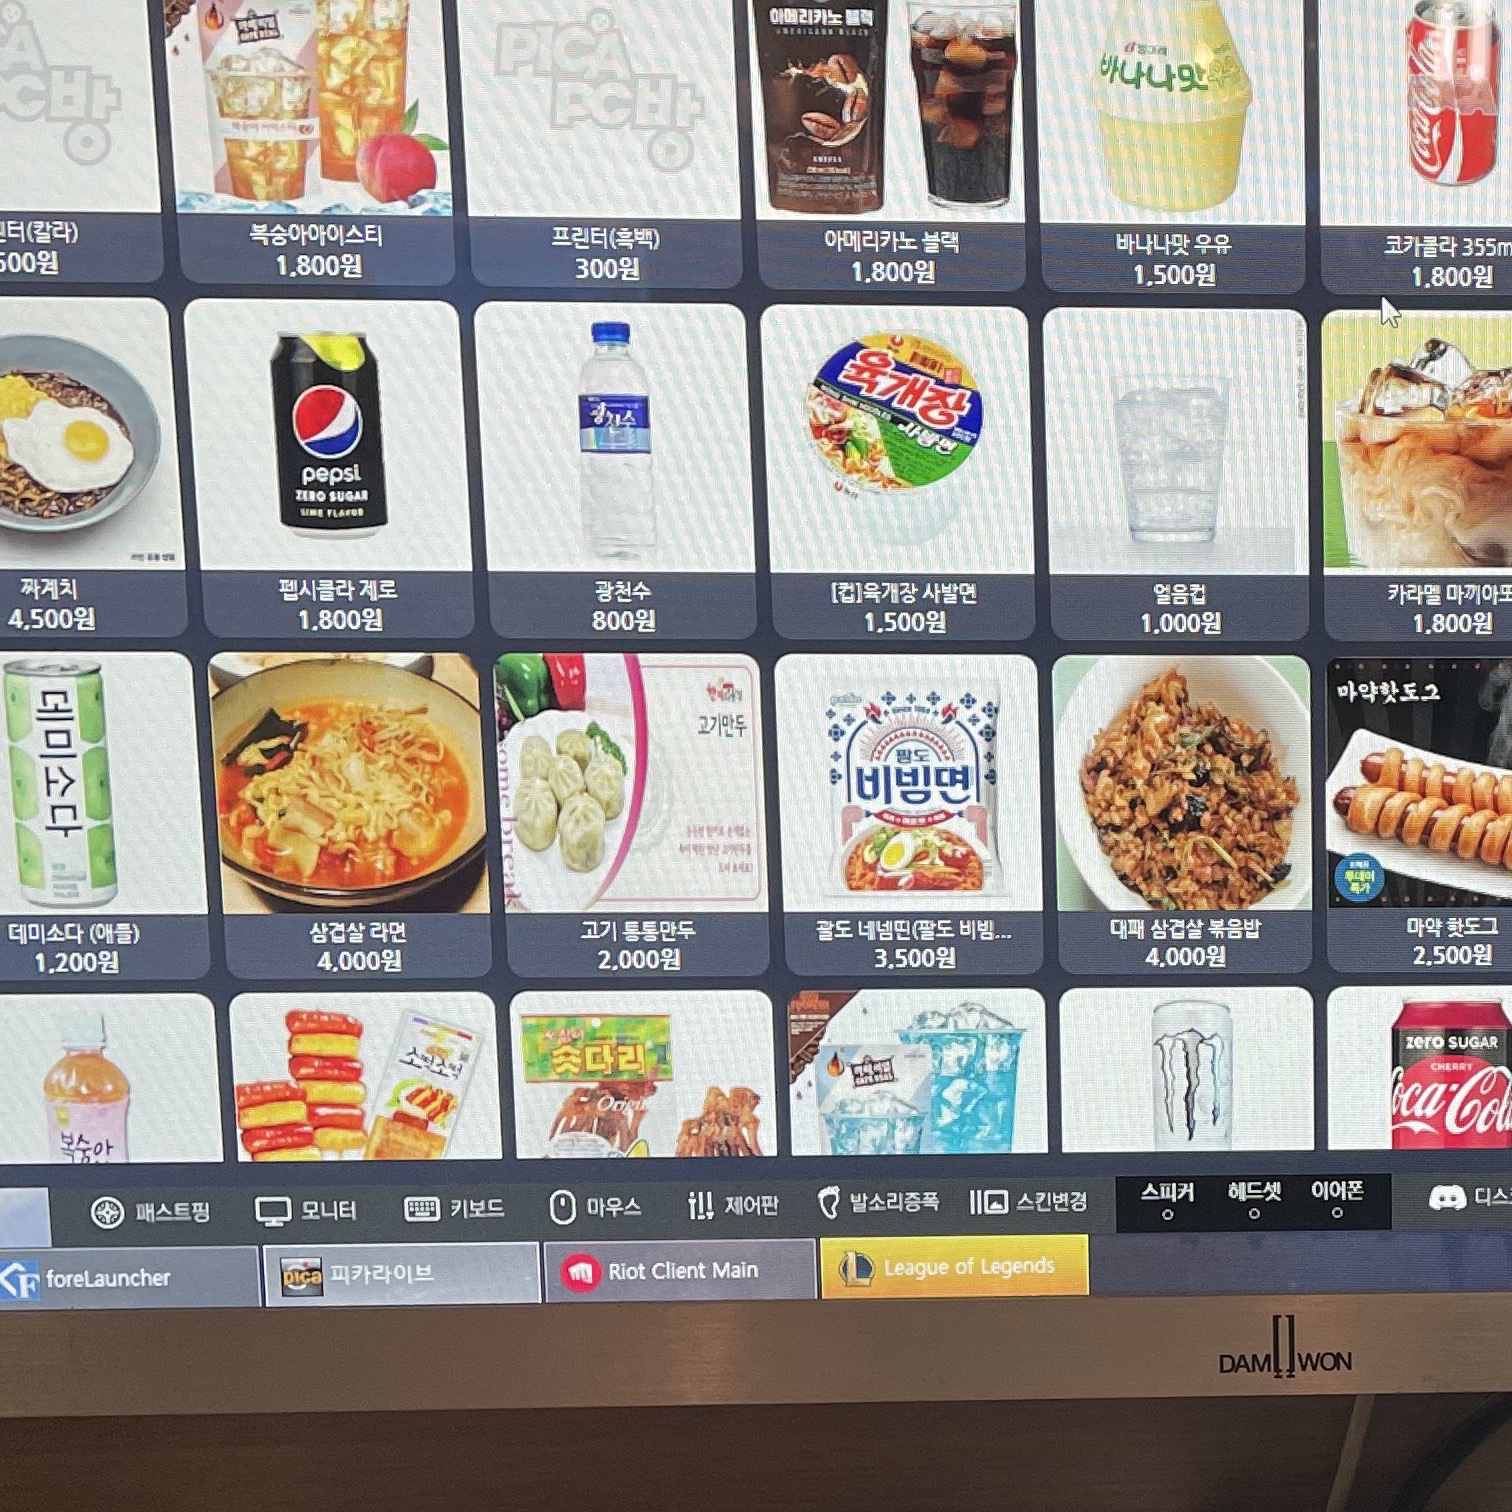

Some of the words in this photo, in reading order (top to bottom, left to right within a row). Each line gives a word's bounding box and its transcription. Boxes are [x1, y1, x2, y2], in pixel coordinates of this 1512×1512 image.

[1101, 53, 1208, 92] 바나나맛
[249, 223, 384, 247] 복숭아아이스티
[551, 227, 661, 251] 프린터(흑백)
[825, 230, 918, 254] 아메리카노
[922, 231, 960, 254] 블랙
[1116, 233, 1190, 256] 바나나맛
[1194, 233, 1233, 255] 우유
[1384, 235, 1458, 258] 코카콜라
[275, 254, 364, 279] 1,800원
[575, 257, 640, 281] 300원
[851, 260, 936, 286] 1,800원
[1133, 263, 1217, 288] 1,500원
[1411, 265, 1494, 290] 1,800원
[838, 347, 972, 429] 육개장
[302, 463, 361, 487] pepsi
[295, 489, 326, 501] ZERO
[329, 490, 368, 502] SUGAR
[20, 577, 78, 601] 짜계치
[279, 578, 355, 602] 펩시콜라
[359, 578, 398, 601] 제로
[595, 580, 653, 604] 광천수
[830, 582, 916, 605] [컵]육개장
[922, 582, 978, 605] 사발면
[1153, 583, 1207, 606] 얼음컵
[1386, 584, 1442, 606] 카라멜
[8, 607, 96, 632] 4,500원
[298, 607, 384, 632] 1,800원
[591, 609, 657, 634] 800원
[864, 611, 948, 635] 1,500원
[1140, 612, 1222, 636] 1,000원
[1413, 612, 1493, 636] 1,800원
[1337, 680, 1441, 704] 마약핫도그
[698, 713, 748, 738] 고기만두
[36, 690, 84, 838] 데미소다
[856, 764, 971, 804] 비빔면
[8, 923, 84, 945] 데미소다
[89, 923, 141, 945] (애플)
[310, 922, 365, 945] 삼겹살
[369, 922, 407, 944] 라면
[581, 920, 617, 943] 고기
[622, 920, 697, 944] 통통만두
[815, 919, 854, 942] 괄도
[858, 919, 954, 943] 네넴띤(팔도
[1110, 918, 1146, 940] 대패
[1151, 918, 1204, 940] 삼겹살
[1208, 917, 1262, 940] 볶음밥
[1406, 917, 1442, 938] 마약
[1446, 917, 1499, 938] 핫도그
[35, 951, 120, 974] 1,200원
[317, 950, 402, 974] 4,000원
[597, 948, 682, 972] 2,000원
[874, 947, 957, 970] 3,500원
[1145, 945, 1228, 969] 4,000원
[1412, 944, 1493, 967] 2,500원
[1448, 1036, 1499, 1049] SUGAR
[1430, 1062, 1474, 1071] CHERRY
[1016, 1190, 1088, 1213] 스킨변경
[1140, 1181, 1195, 1203] 스피커
[1228, 1181, 1282, 1202] 헤드셋
[1311, 1180, 1365, 1201] 이어폰
[135, 1201, 210, 1223] 패스트핑
[302, 1200, 357, 1221] 모니터
[450, 1198, 505, 1220] 키보드
[587, 1196, 642, 1217] 마우스
[724, 1195, 779, 1217] 제어판
[850, 1192, 939, 1214] 발소리증폭
[46, 1268, 171, 1289] foreLauncher
[330, 1264, 435, 1284] 피카라이브
[609, 1261, 647, 1281] Riot
[652, 1260, 707, 1280] Client
[713, 1260, 759, 1279] Main
[884, 1258, 948, 1280] League
[955, 1257, 975, 1276] of
[980, 1255, 1055, 1278] Legends
